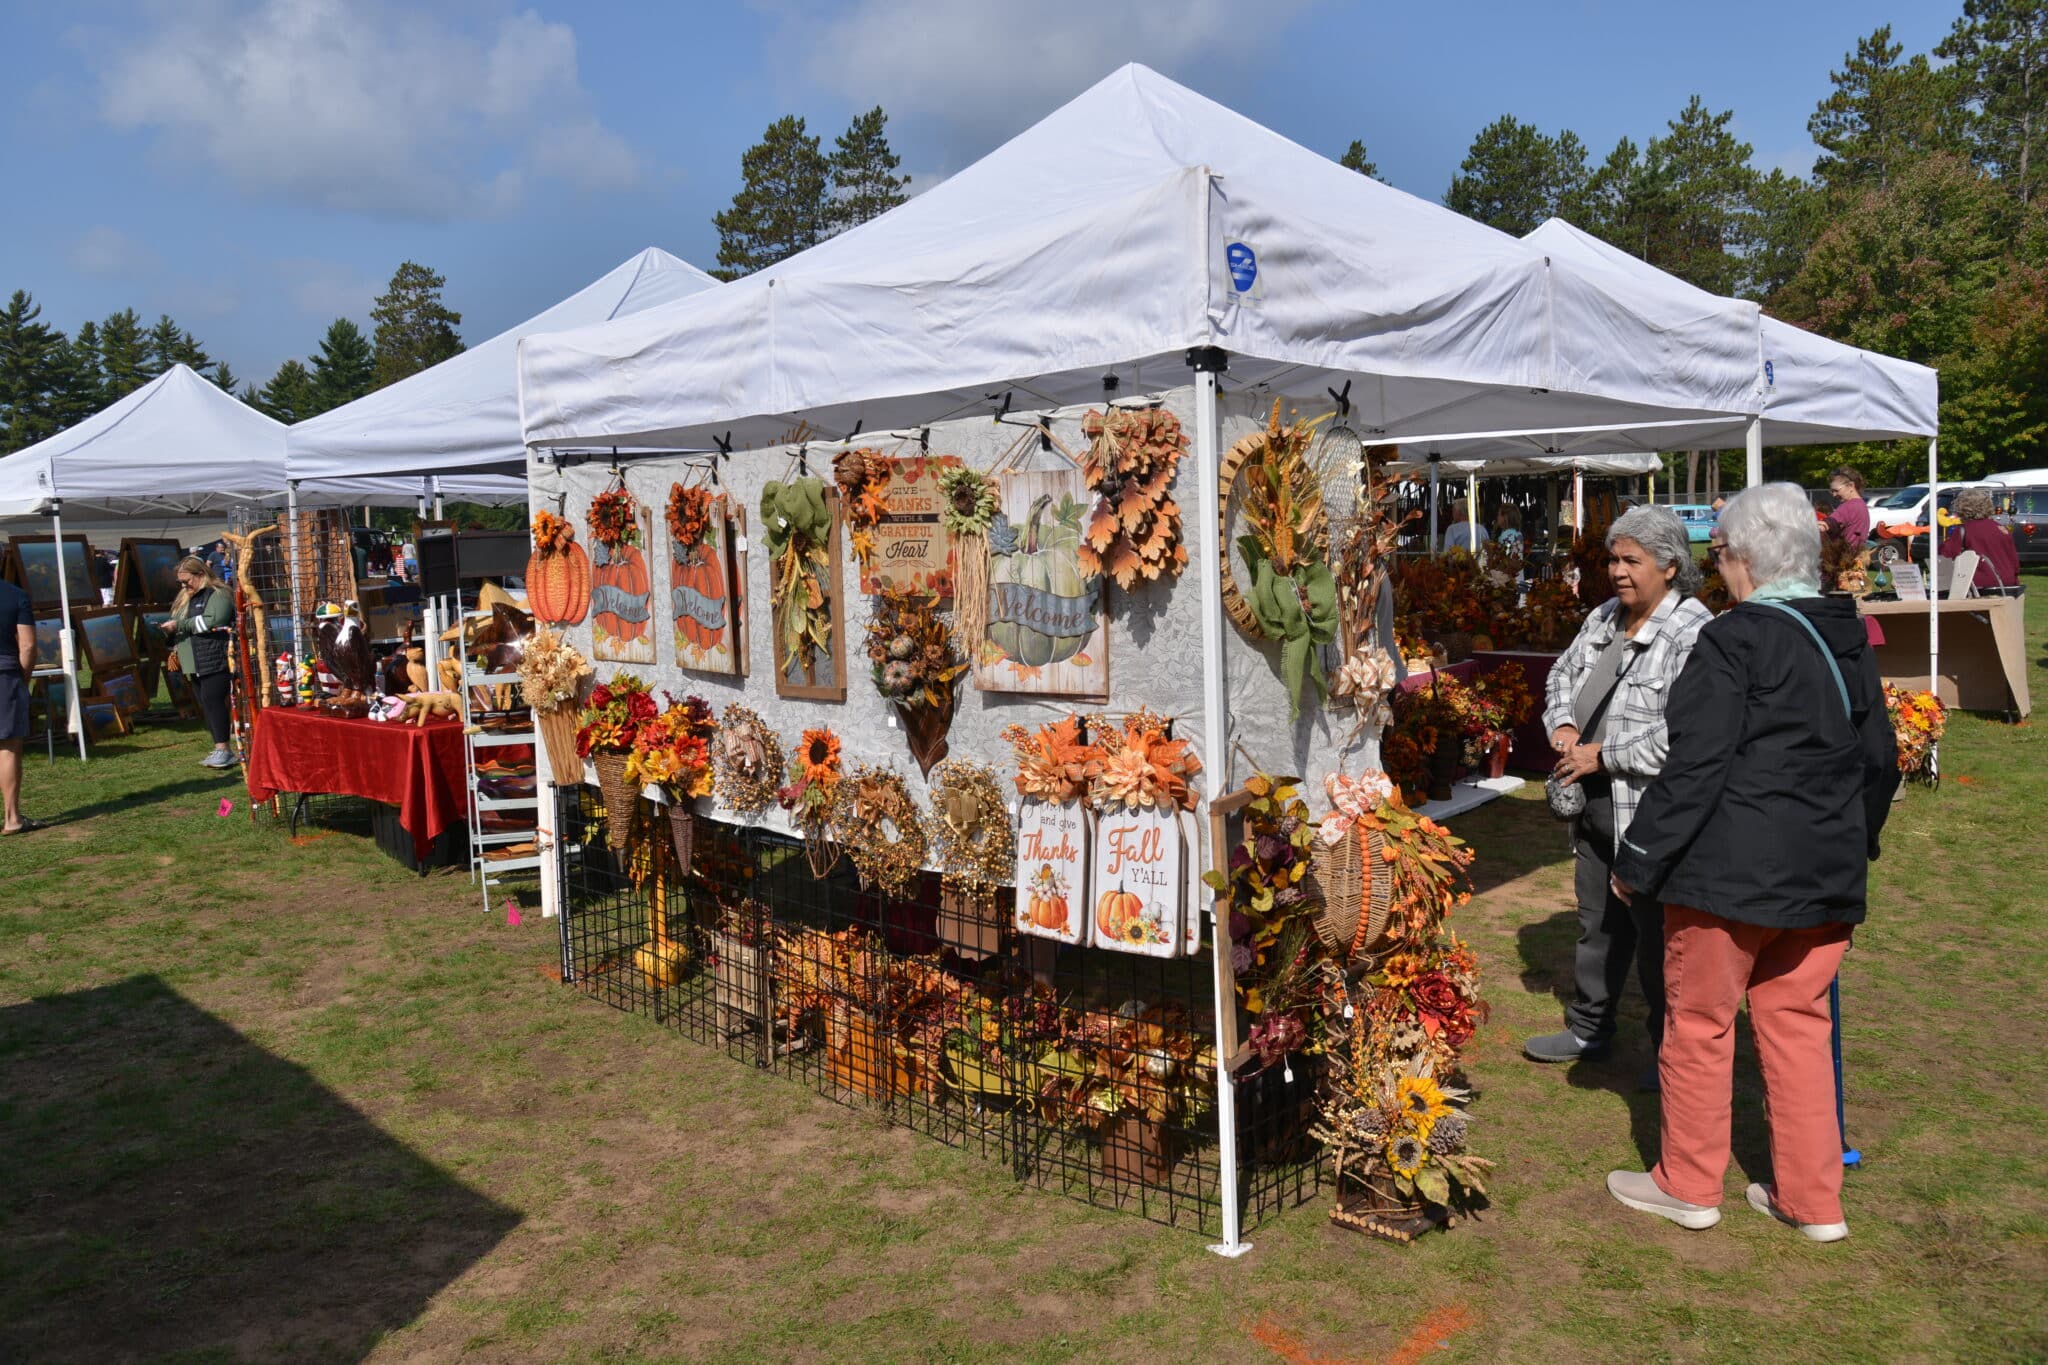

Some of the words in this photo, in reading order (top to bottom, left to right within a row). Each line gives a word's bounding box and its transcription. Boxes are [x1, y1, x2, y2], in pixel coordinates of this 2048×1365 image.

[892, 486, 919, 496] GIVE
[887, 497, 932, 512] HANKS
[880, 525, 934, 538] GRATEFUL
[885, 539, 930, 559] Heart
[677, 589, 722, 624] Welcome
[990, 587, 1083, 630] Welcome
[1040, 814, 1056, 827] and
[1058, 818, 1078, 833] give
[1022, 826, 1079, 864] Thanks
[1107, 824, 1165, 875] Fall
[1131, 867, 1168, 886] Y'ALL
